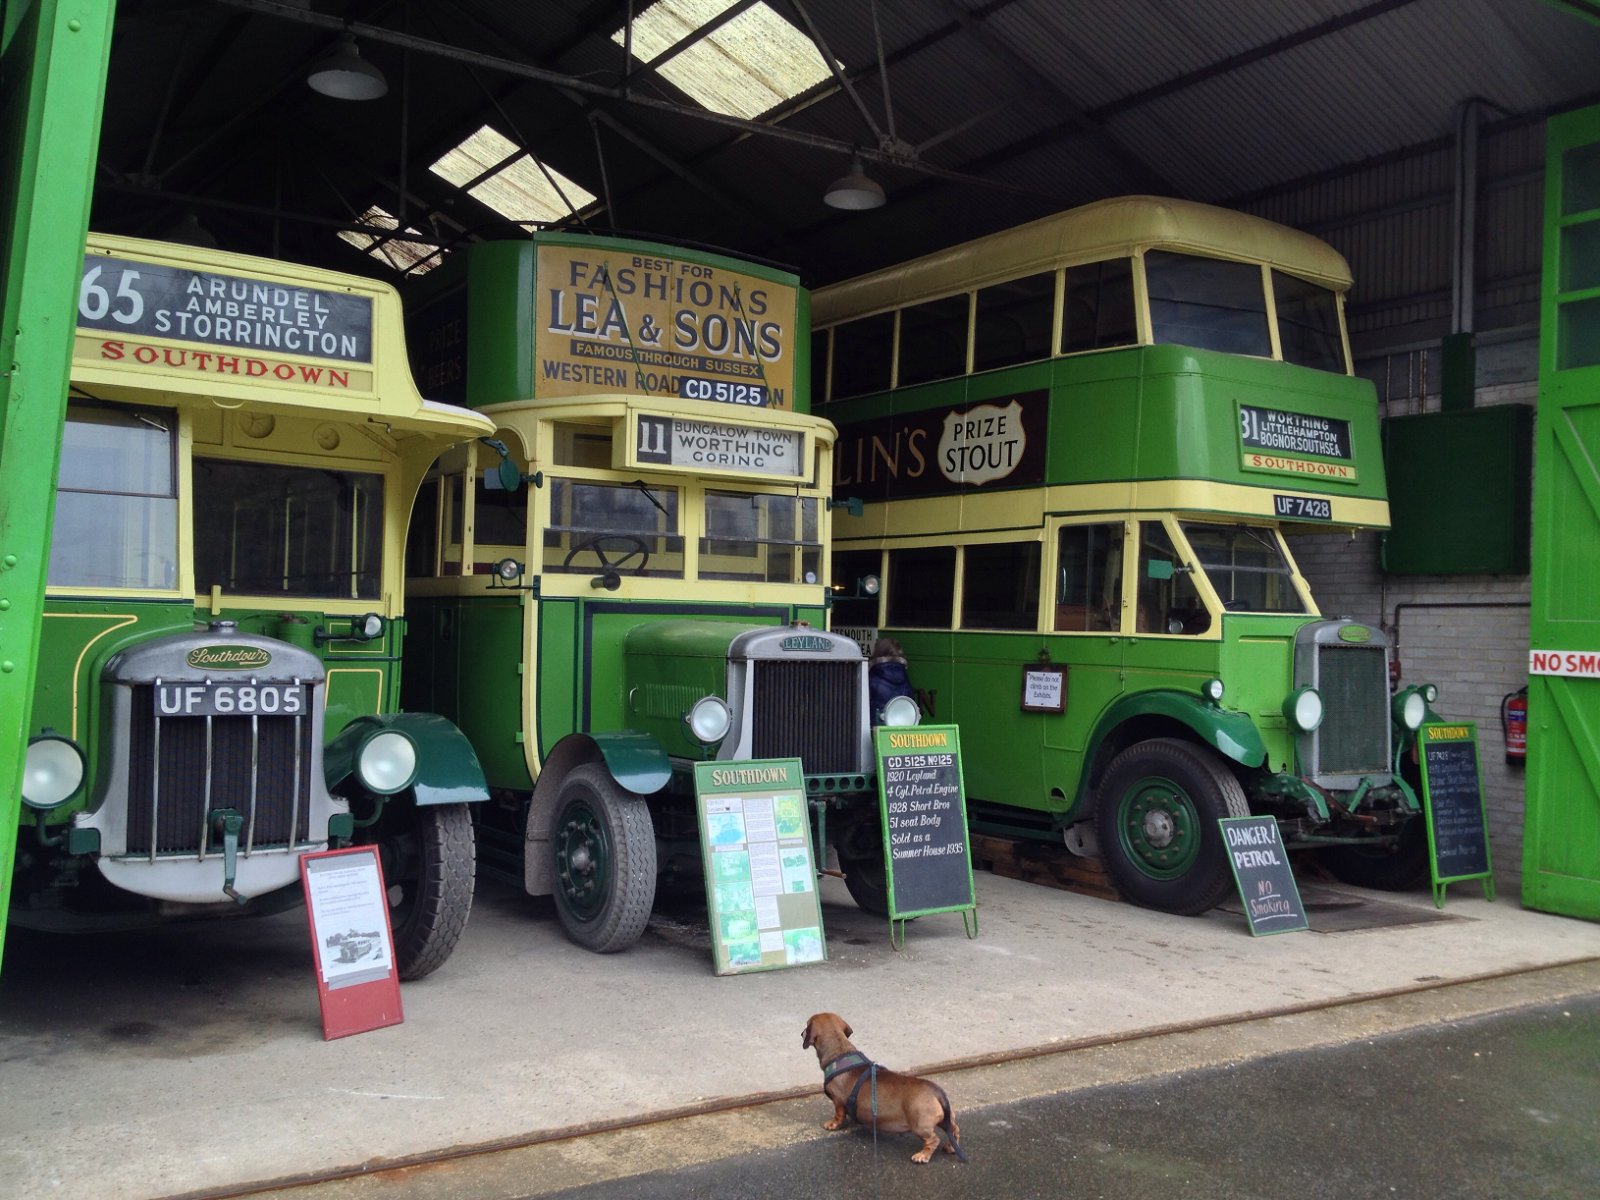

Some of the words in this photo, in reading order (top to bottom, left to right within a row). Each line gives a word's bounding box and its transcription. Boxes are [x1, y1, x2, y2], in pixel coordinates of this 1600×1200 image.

[632, 256, 674, 273] BEST
[681, 264, 713, 280] FOR
[78, 265, 145, 324] 65
[186, 276, 330, 313] ARUNDEL
[569, 260, 768, 315] FASHIONS
[186, 297, 328, 330] AMBERLEY
[154, 309, 357, 358] STORRINGTON
[547, 289, 630, 343] LEA
[638, 313, 663, 347] &
[674, 309, 783, 363] SONS
[101, 341, 350, 388] SOUTHDOWN
[576, 342, 634, 360] FAMOUS
[637, 348, 699, 369] THROUGH
[705, 360, 759, 376] SUSSEX
[542, 359, 627, 388] WESTERN
[635, 371, 681, 395] ROAD
[685, 379, 712, 401] CD
[715, 383, 762, 406] 5125
[953, 416, 1006, 441] PRIZE
[1267, 410, 1329, 431] WORTHING
[674, 421, 749, 439] BUNGALOW
[753, 430, 792, 444] TOWN
[1261, 421, 1337, 442] LITTLEHAMPTON
[679, 435, 784, 457] WORTHING
[945, 439, 1018, 473] STOUT
[692, 451, 765, 467] GORING
[1252, 456, 1347, 477] SOUTHDOWN
[1277, 497, 1294, 513] UF
[1296, 499, 1330, 517] 7428
[784, 637, 832, 650] LEYLAND
[190, 648, 268, 665] Southdown
[1533, 653, 1562, 671] NO
[1566, 655, 1600, 673] SM
[160, 687, 206, 714] UF
[214, 687, 300, 713] 6805
[889, 733, 948, 748] SOUTHDOWN
[1428, 727, 1470, 740] SOUTHDOWN
[888, 757, 902, 768] CD
[905, 755, 926, 767] 5125
[938, 755, 952, 765] 125
[712, 767, 788, 786] SOUTHDOWN
[887, 771, 905, 782] 1920
[906, 769, 938, 783] Leyland
[887, 785, 893, 797] 4
[911, 784, 932, 796] Petrol
[934, 783, 959, 796] Engine
[889, 801, 908, 814] 1928
[910, 800, 932, 812] Short
[933, 799, 950, 810] Bros
[889, 817, 898, 829] 51
[900, 817, 919, 828] seat
[920, 814, 942, 828] Body
[891, 832, 911, 845] Sold
[913, 835, 923, 843] as
[924, 833, 931, 842] a
[893, 848, 922, 860] Summer
[923, 845, 946, 857] House
[946, 842, 964, 855] 1935
[1234, 850, 1280, 869] PETROL
[1258, 880, 1272, 895] NO
[1251, 899, 1290, 917] Smoking
